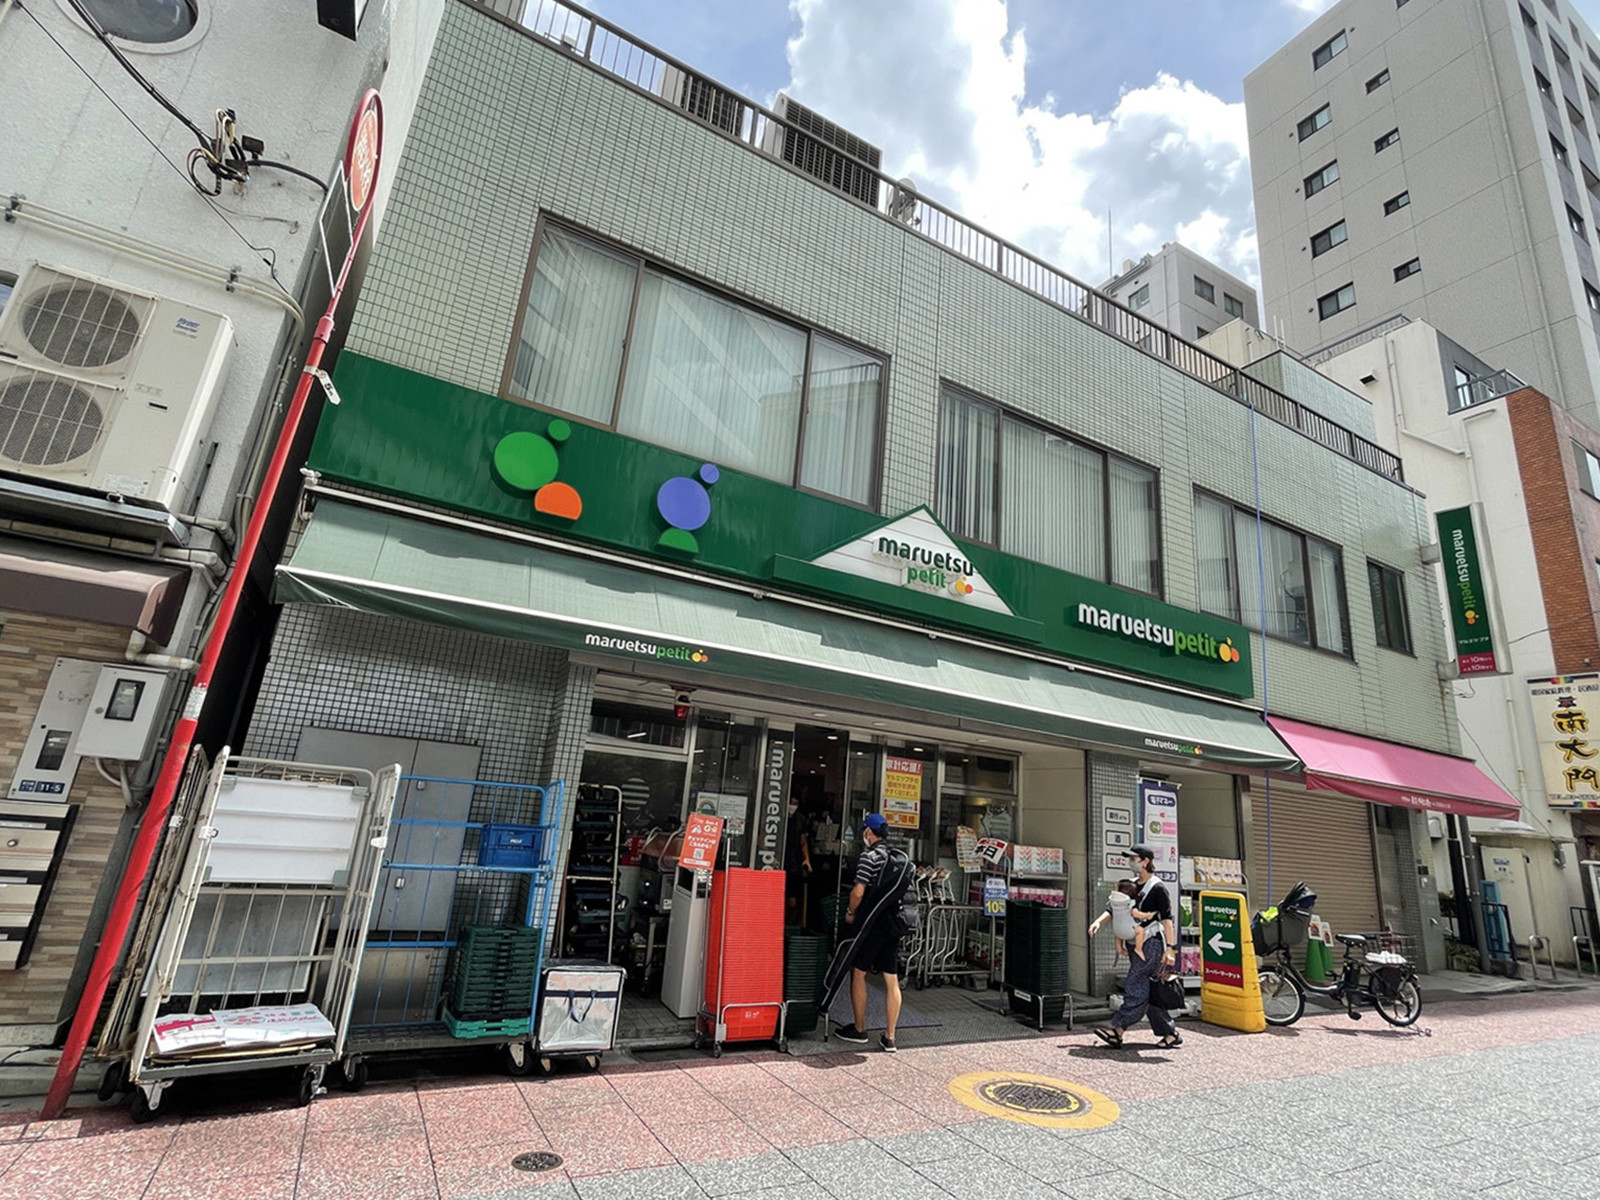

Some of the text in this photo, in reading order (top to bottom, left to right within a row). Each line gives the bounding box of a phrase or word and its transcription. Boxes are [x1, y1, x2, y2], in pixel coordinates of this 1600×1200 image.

[878, 536, 974, 577] maruetsu
[906, 566, 946, 588] petit
[585, 633, 691, 660] maruetsupetit
[1078, 602, 1218, 660] maruetsupetit
